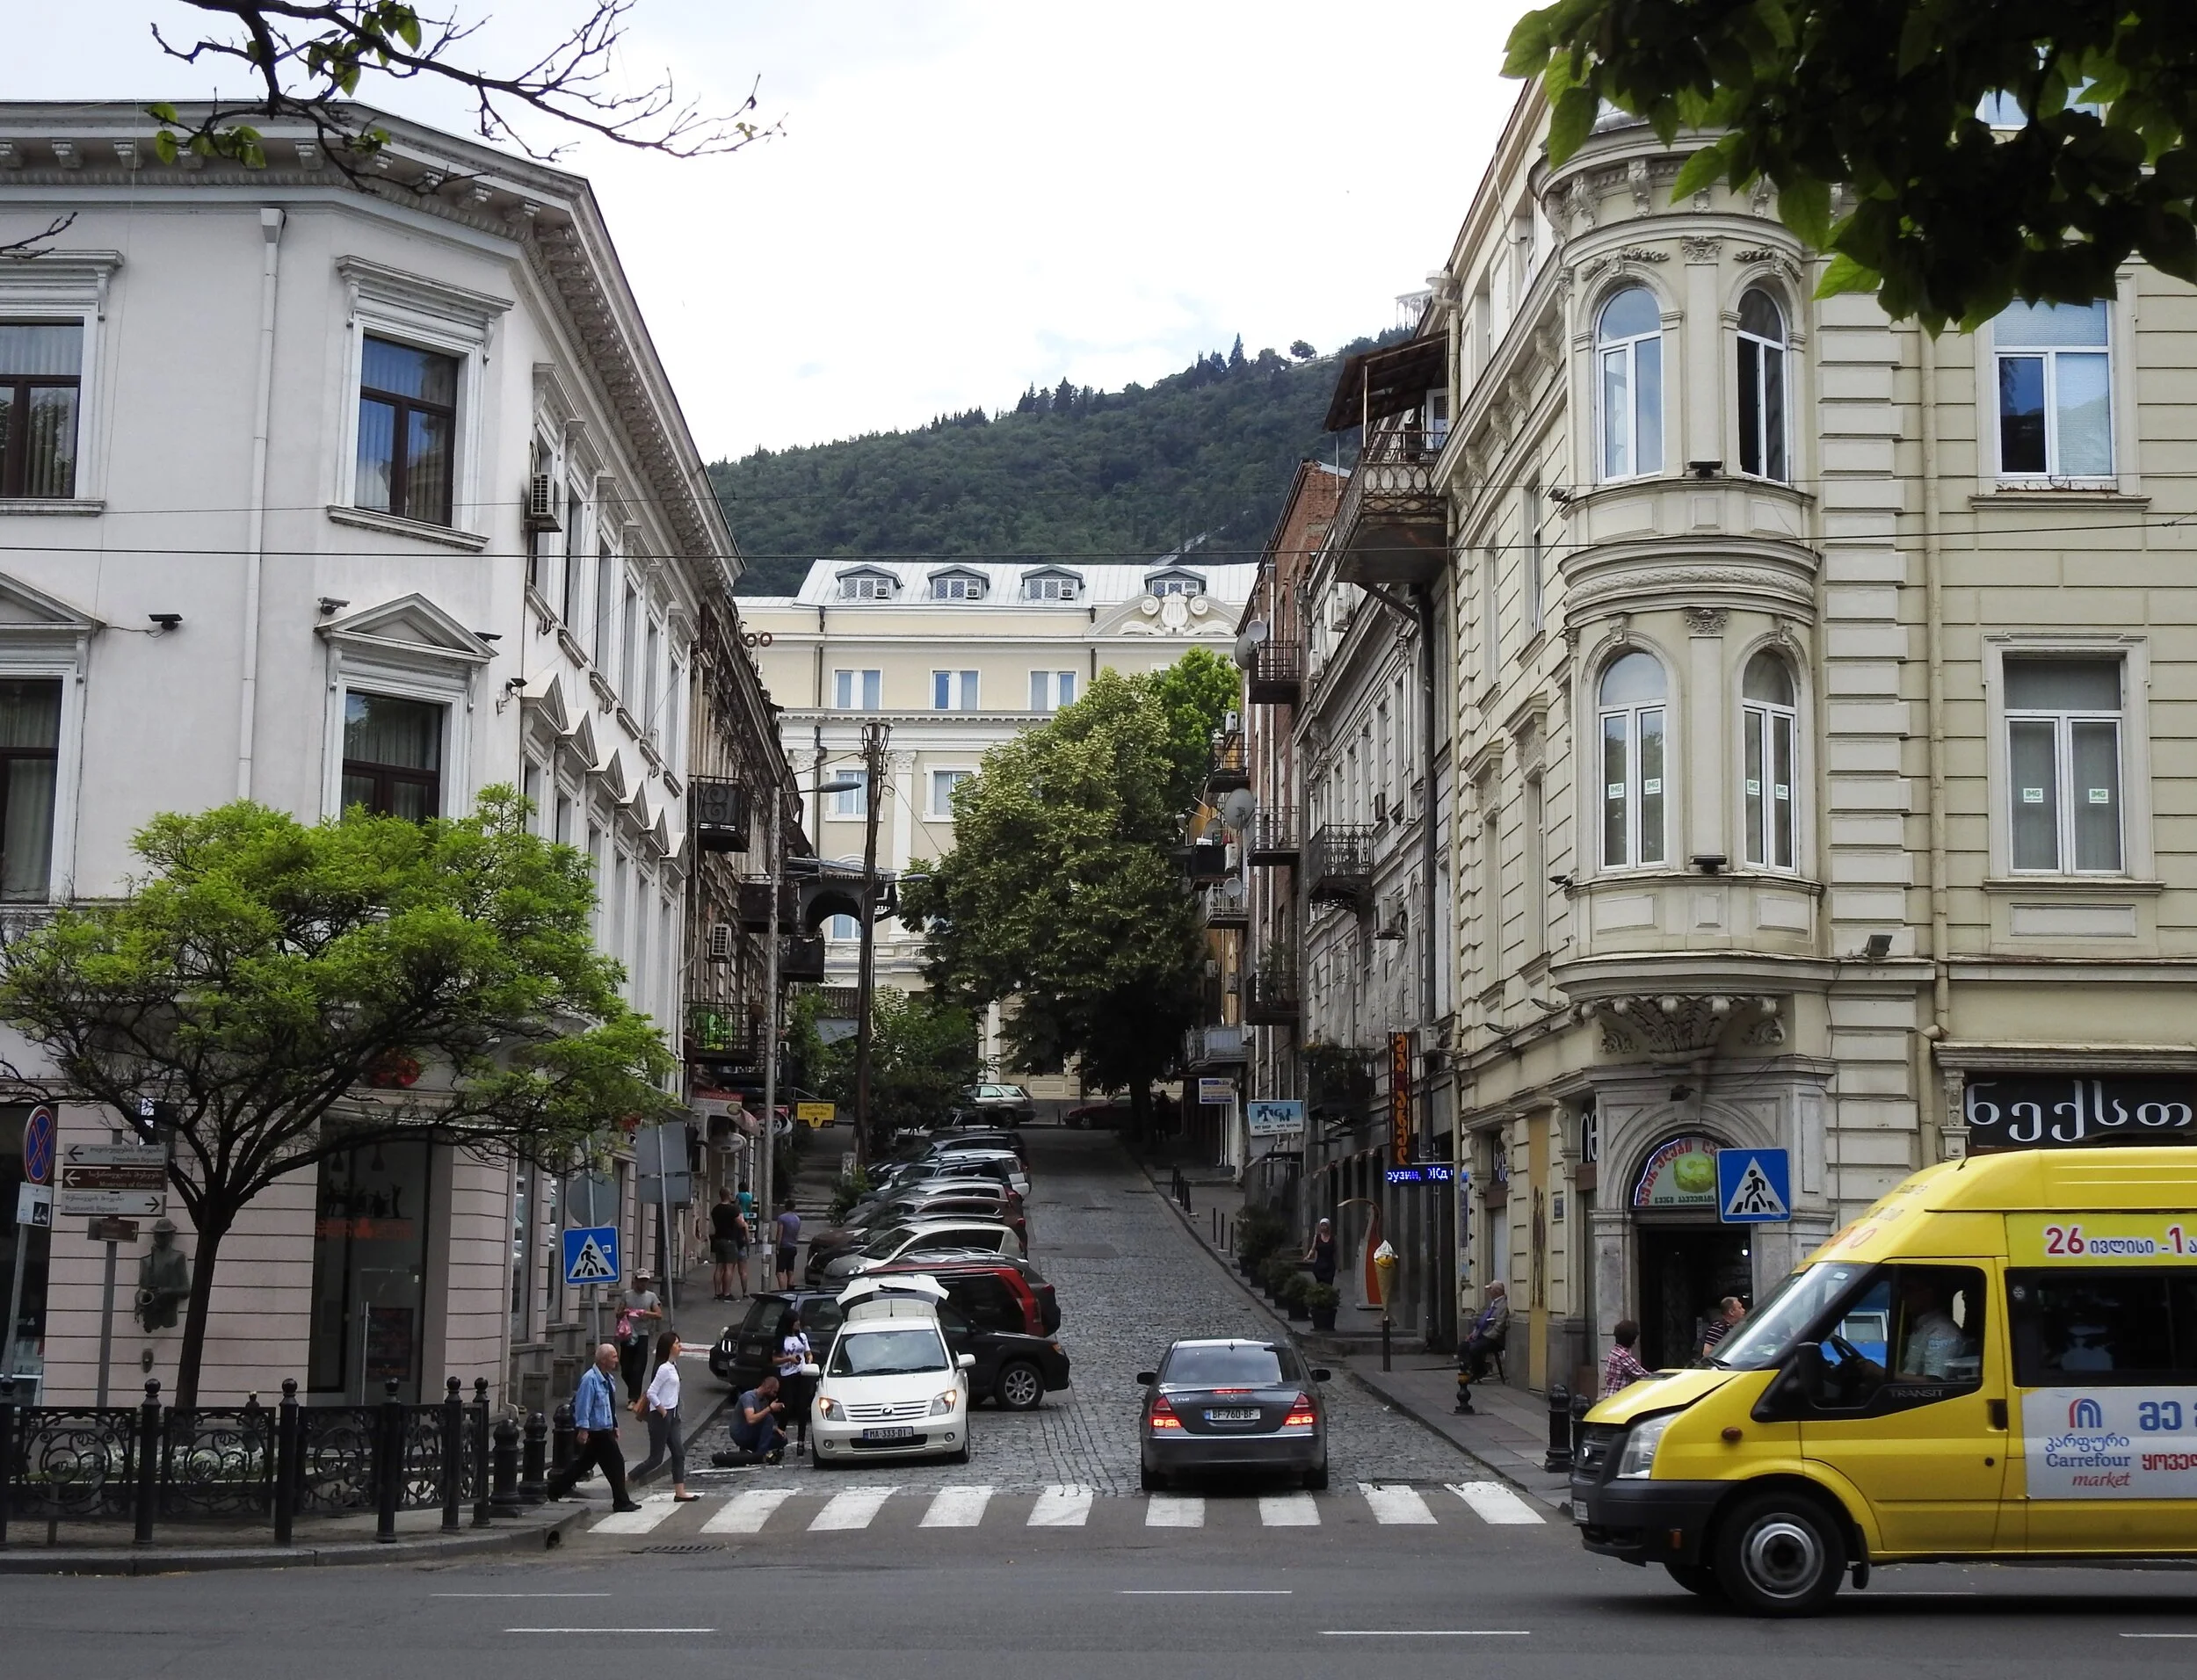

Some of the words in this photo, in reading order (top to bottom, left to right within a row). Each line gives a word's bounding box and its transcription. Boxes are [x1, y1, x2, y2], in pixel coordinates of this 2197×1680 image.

[1966, 1080, 2193, 1142] ნექსთ
[2046, 1227, 2085, 1255] 26
[2089, 1239, 2154, 1255] ივლისი
[1888, 1387, 1946, 1399] TRANSIT
[2138, 1401, 2183, 1431] მე
[2045, 1432, 2130, 1452] კარფური
[2046, 1452, 2131, 1467] Carrefour
[2072, 1471, 2131, 1488] market
